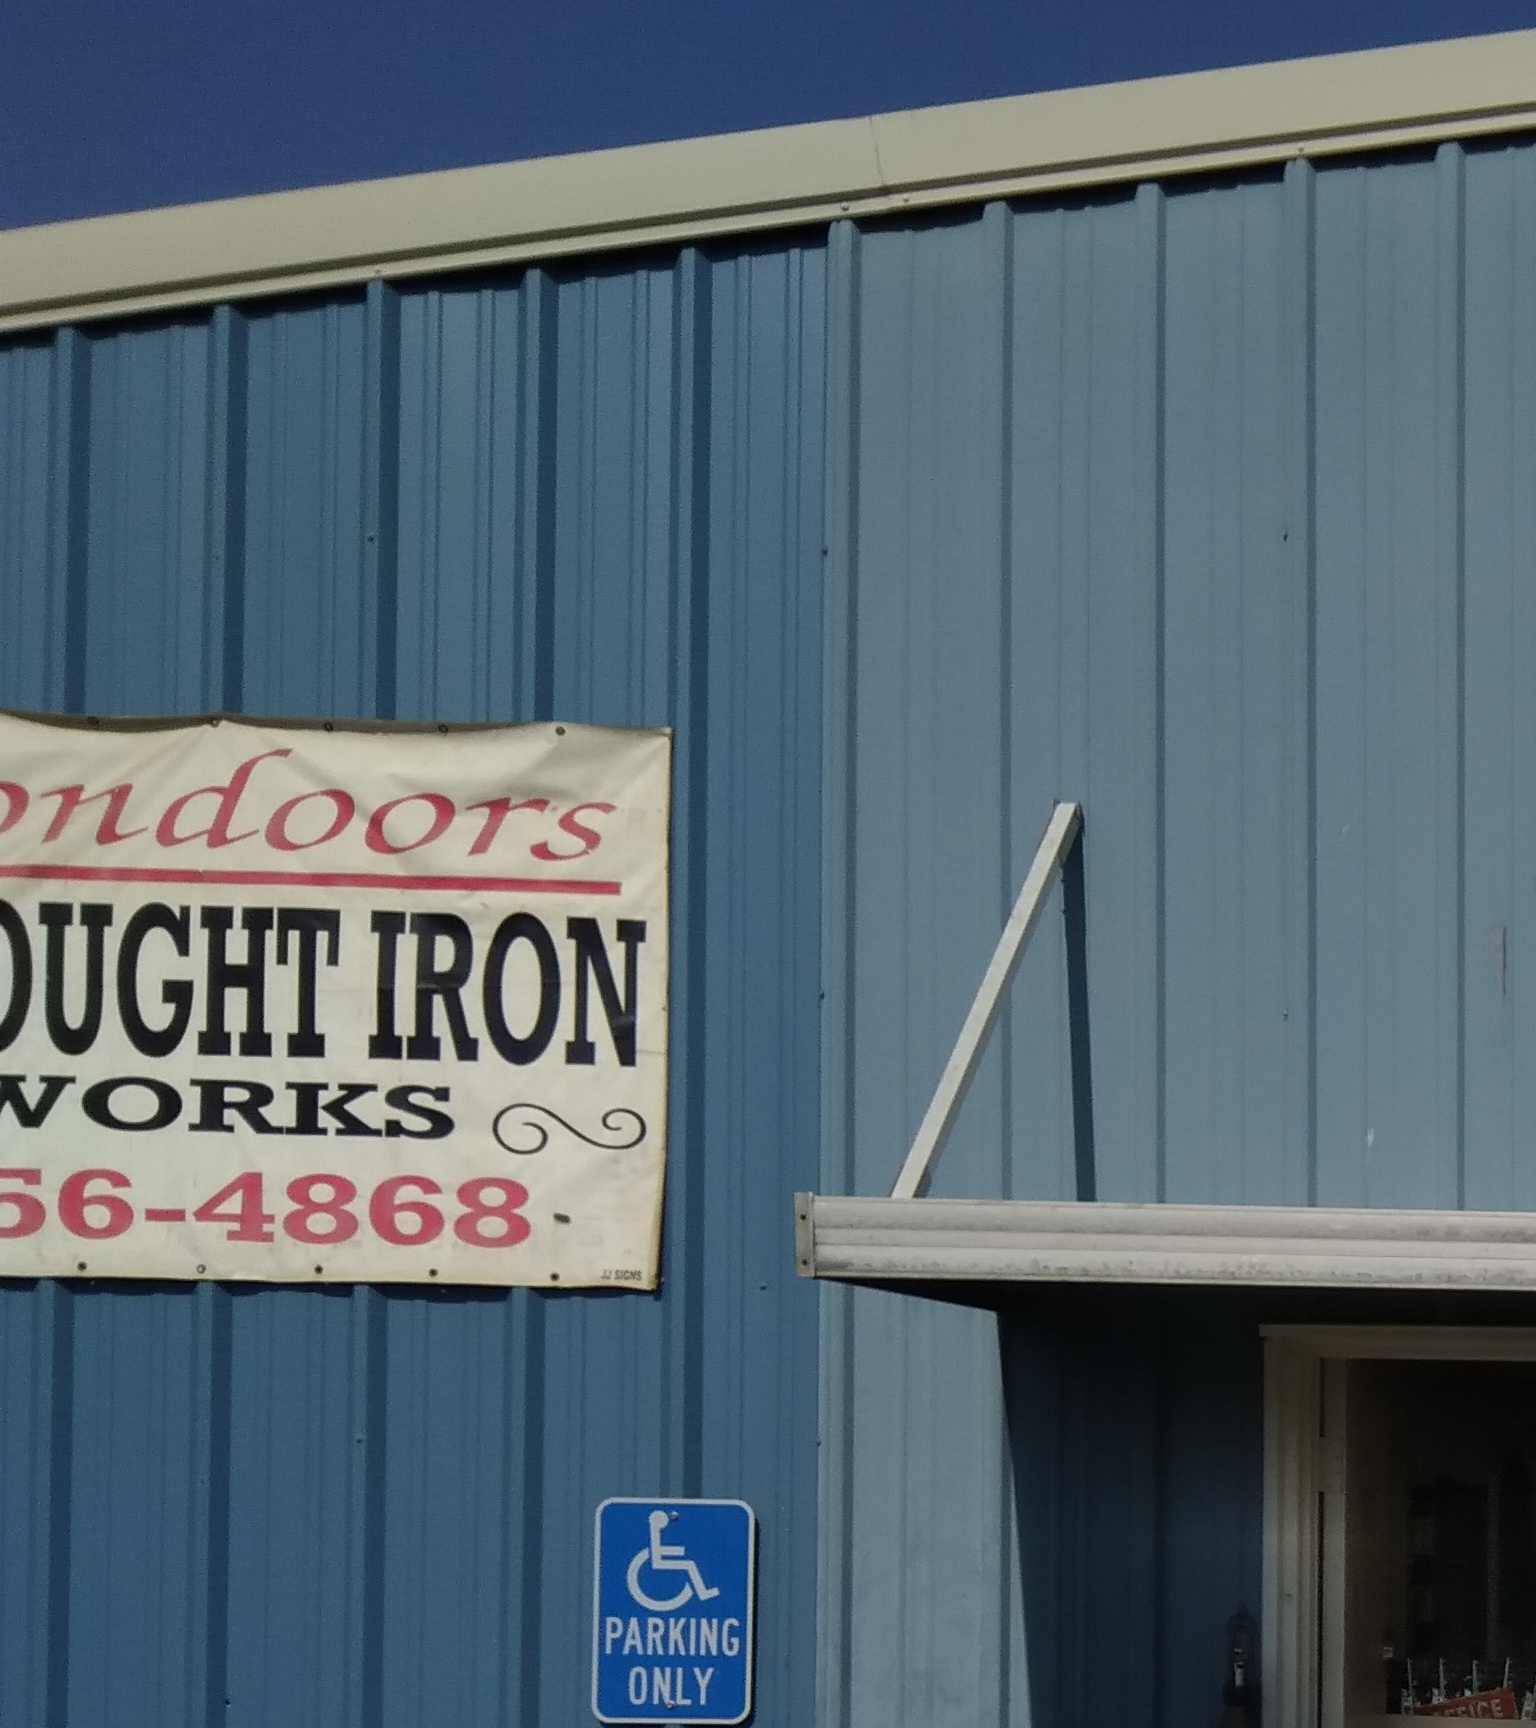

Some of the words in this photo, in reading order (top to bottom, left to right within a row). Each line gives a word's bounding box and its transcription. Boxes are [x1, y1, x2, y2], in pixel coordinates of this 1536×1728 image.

[368, 910, 647, 1067] IRON
[614, 1269, 642, 1281] SIGNS
[605, 1616, 740, 1657] PARKING
[628, 1666, 714, 1706] ONLY
